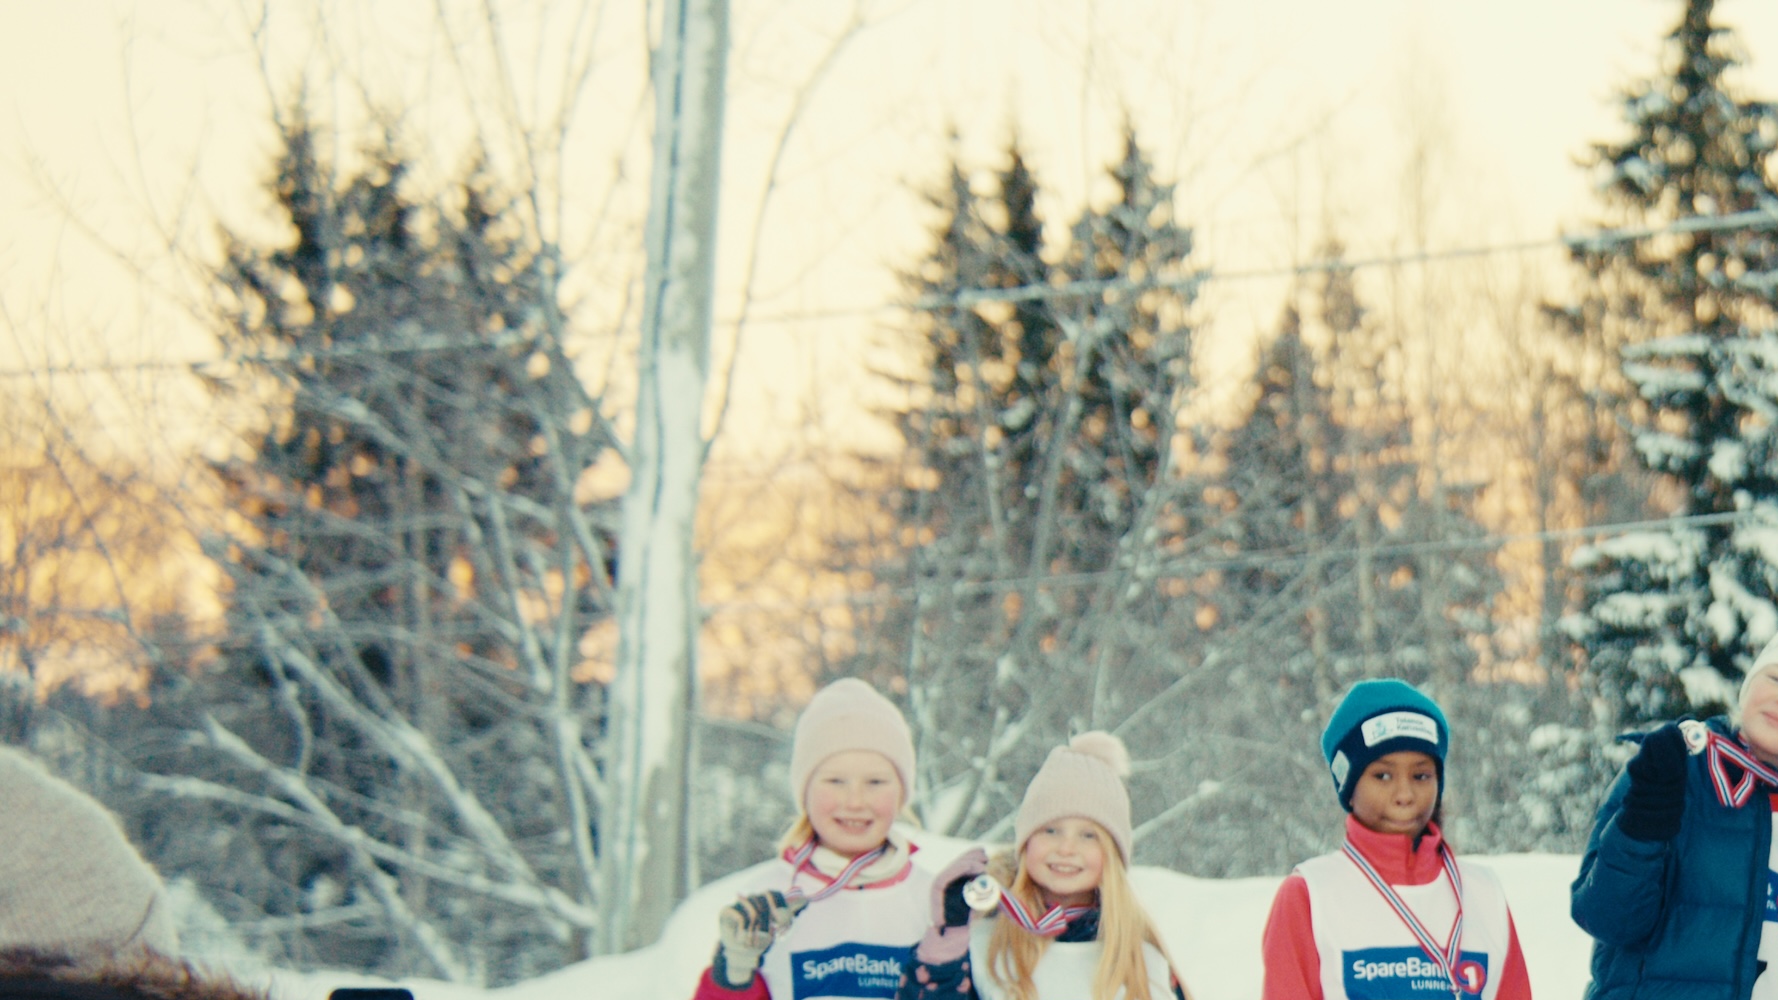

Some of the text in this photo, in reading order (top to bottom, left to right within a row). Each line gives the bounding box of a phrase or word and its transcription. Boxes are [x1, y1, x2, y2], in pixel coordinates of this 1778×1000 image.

[802, 953, 901, 981] SpareBank
[1352, 956, 1478, 991] SpareBan 1
[1411, 979, 1453, 991] LUNNE
